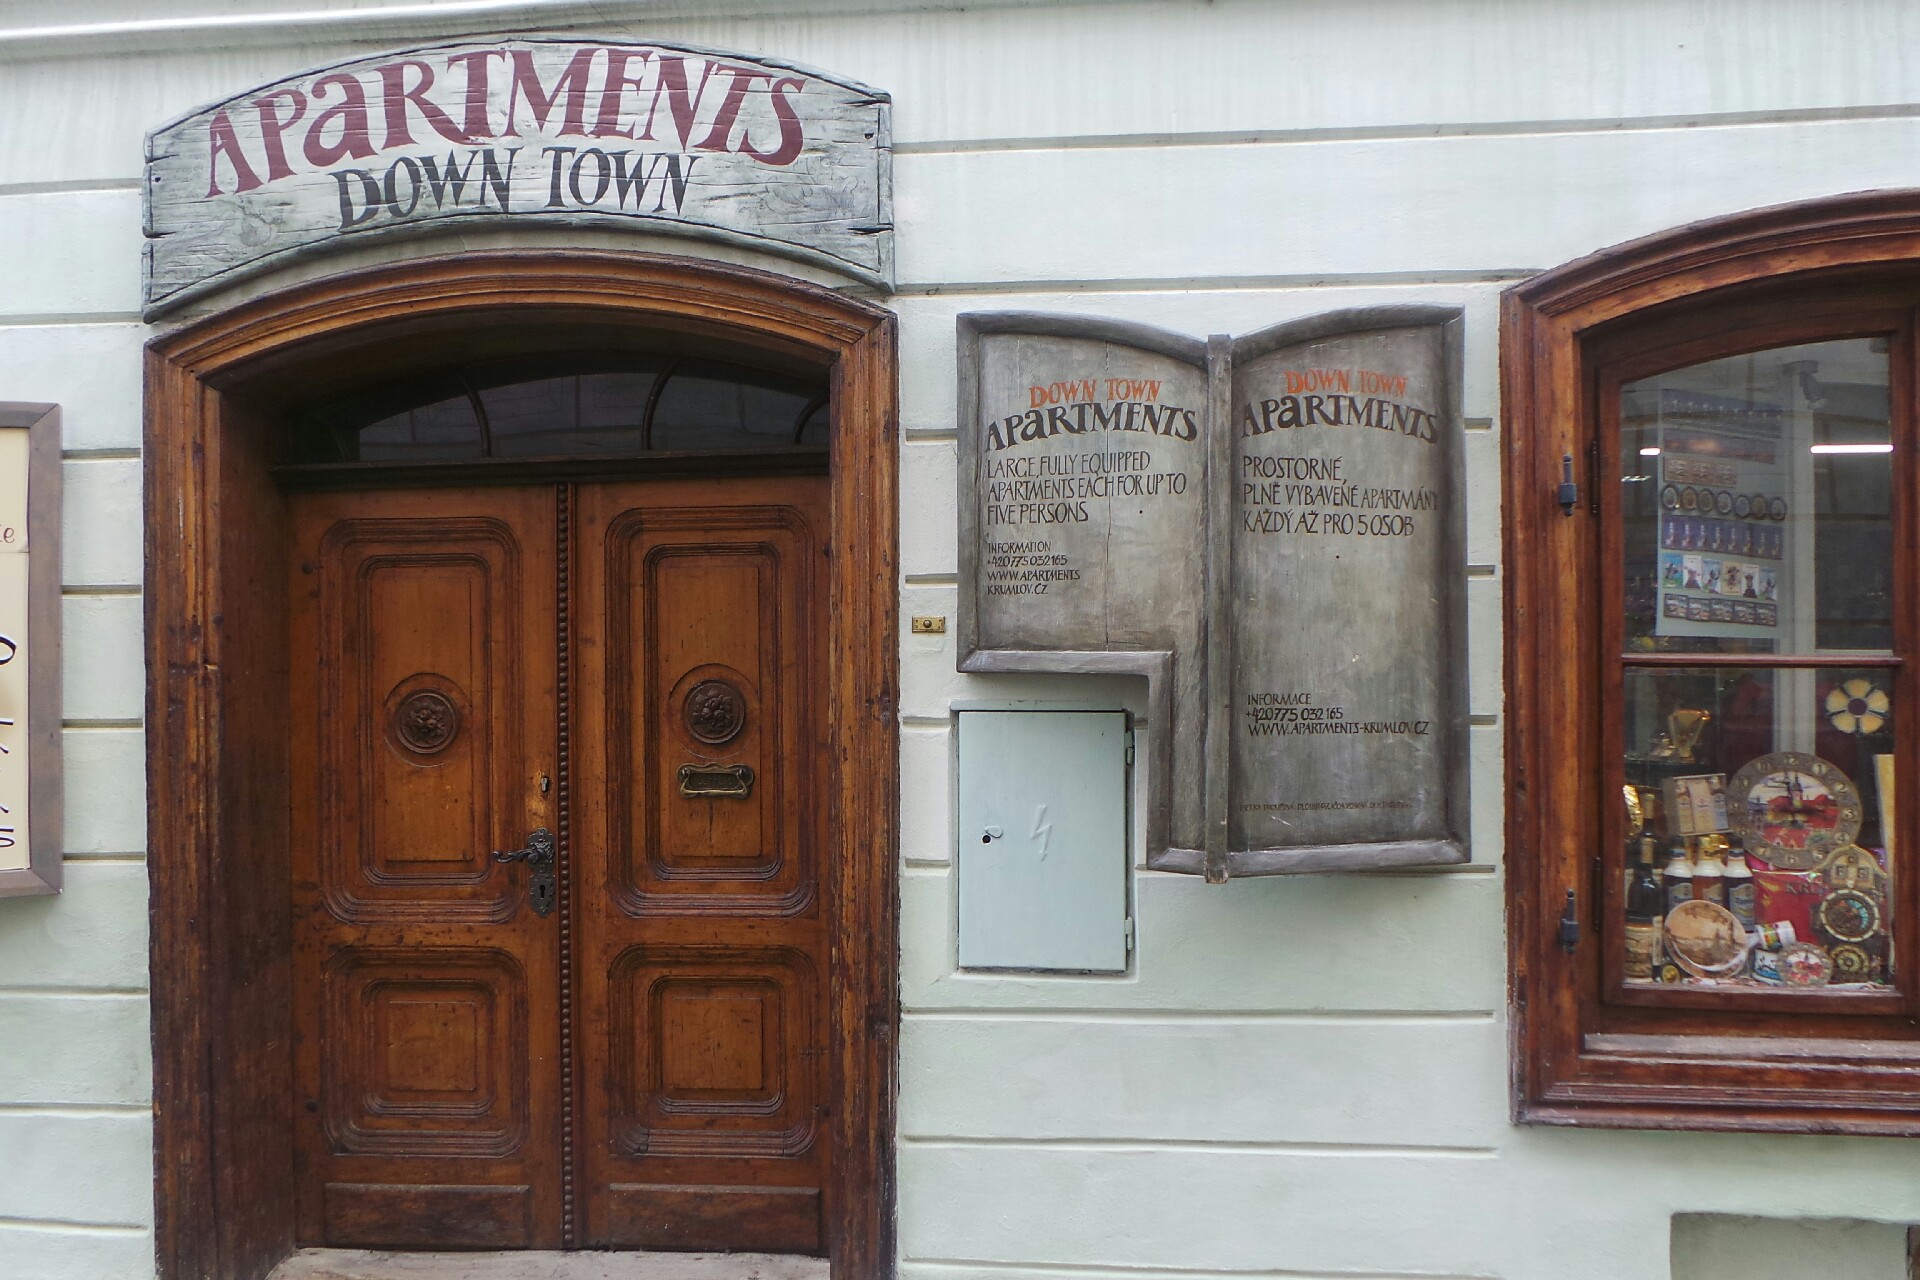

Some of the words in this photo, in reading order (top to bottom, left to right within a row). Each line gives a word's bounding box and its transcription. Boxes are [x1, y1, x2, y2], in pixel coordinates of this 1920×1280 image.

[329, 147, 519, 233] DOWN
[541, 146, 702, 216] TOWN
[1029, 379, 1098, 409] DOWN
[1104, 378, 1164, 403] TOWN
[1285, 368, 1351, 394] DOWN
[1357, 370, 1408, 398] TOWN
[1081, 450, 1151, 477] EQUIPPED
[1243, 455, 1348, 485] PROSTORNÉ,
[987, 477, 1076, 503] APARTMENTS
[1078, 476, 1115, 499] EACH
[1117, 474, 1144, 497] FOR
[1146, 473, 1164, 495] UP
[1166, 472, 1187, 495] TO
[1243, 482, 1281, 506] PLNĚ
[1285, 484, 1359, 508] VYBAVENÉ
[987, 504, 1016, 525] FIVE
[1019, 501, 1089, 524] PERSONS
[1243, 508, 1294, 534] KAŽDÝ
[1294, 509, 1319, 534] AŽ
[1323, 513, 1354, 535] PRO
[1357, 514, 1368, 536] 5
[1370, 514, 1414, 537] OSOB
[988, 540, 1052, 554] INFORMATION
[987, 569, 1081, 582] WWW.APARTMENTS
[987, 583, 1049, 596] KRUMLOV.CZ
[1247, 692, 1312, 706] INFORMACE
[1300, 707, 1324, 721] 032
[1326, 706, 1344, 720] 165
